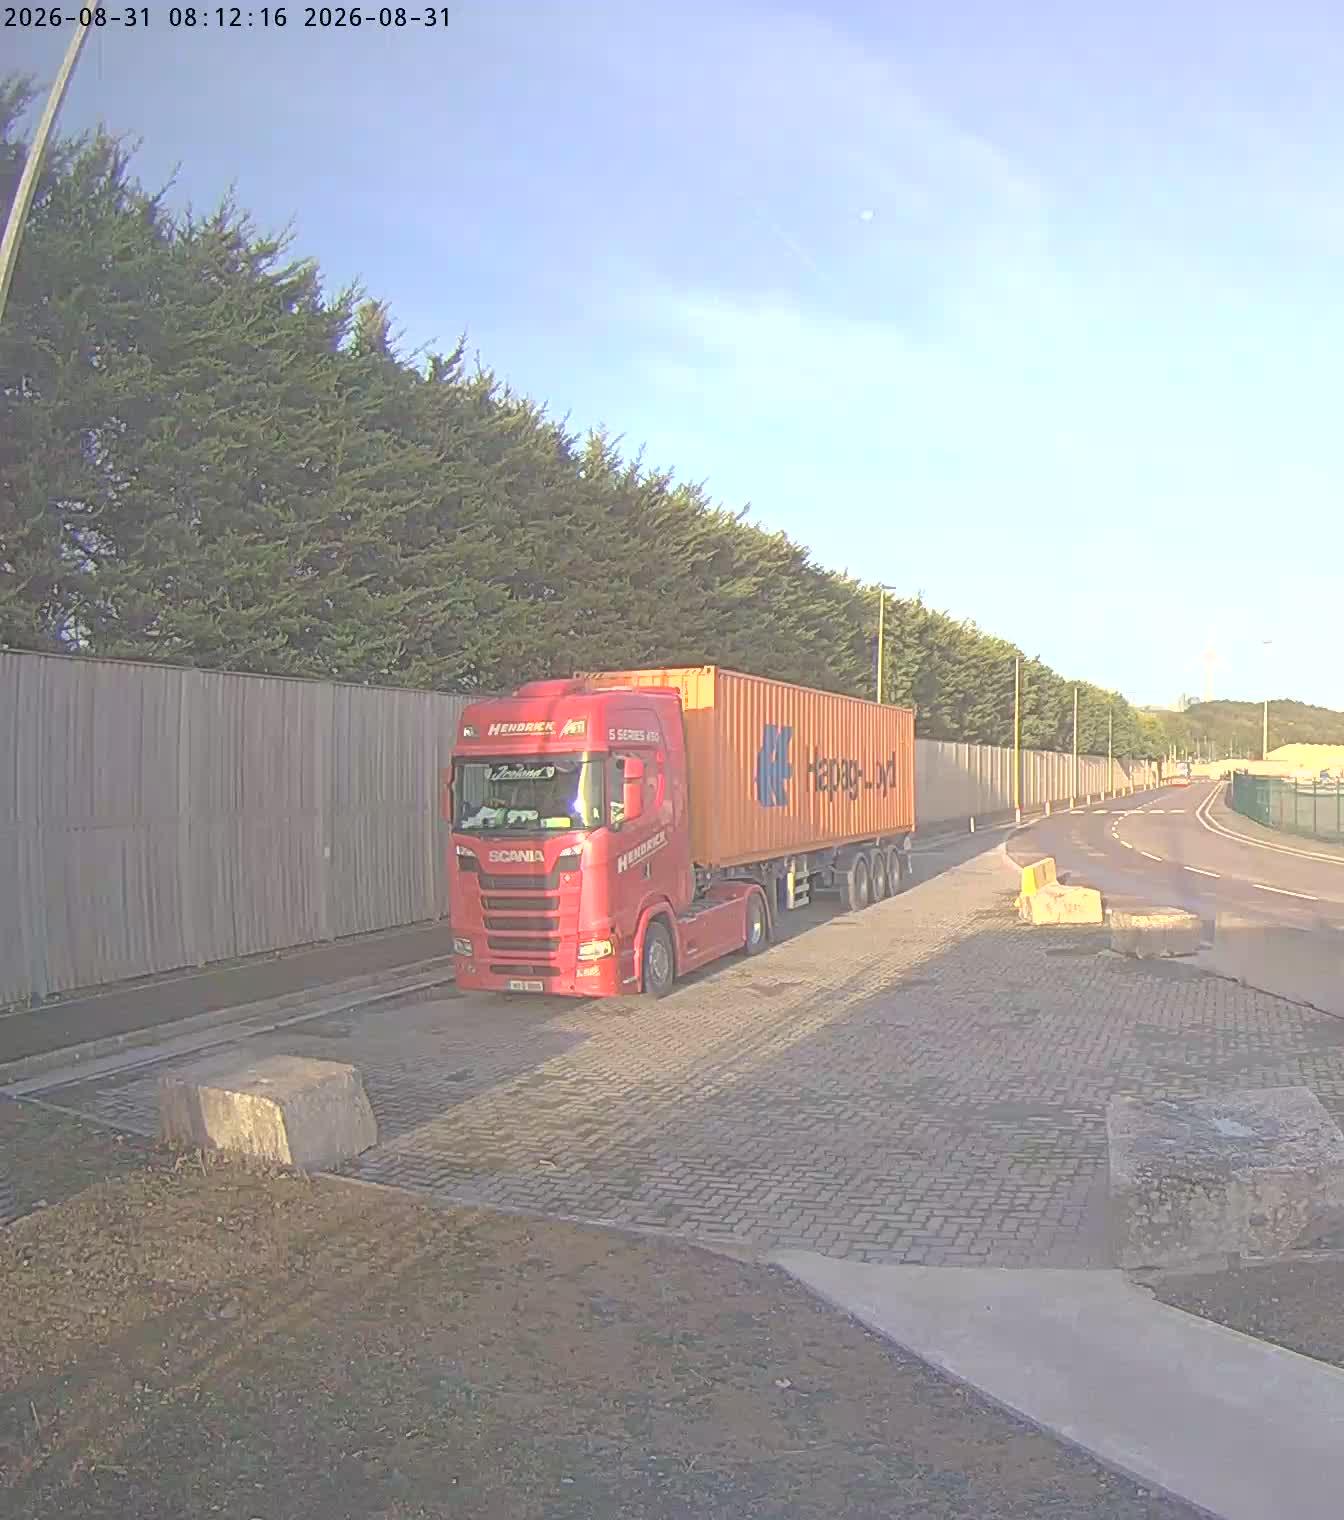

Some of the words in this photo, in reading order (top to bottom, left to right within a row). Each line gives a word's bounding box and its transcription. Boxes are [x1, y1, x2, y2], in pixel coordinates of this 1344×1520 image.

[488, 721, 556, 736] HENDRICK
[807, 746, 896, 802] Hapag-oyd
[488, 850, 545, 863] SCANIA
[617, 831, 668, 873] HENDRICK
